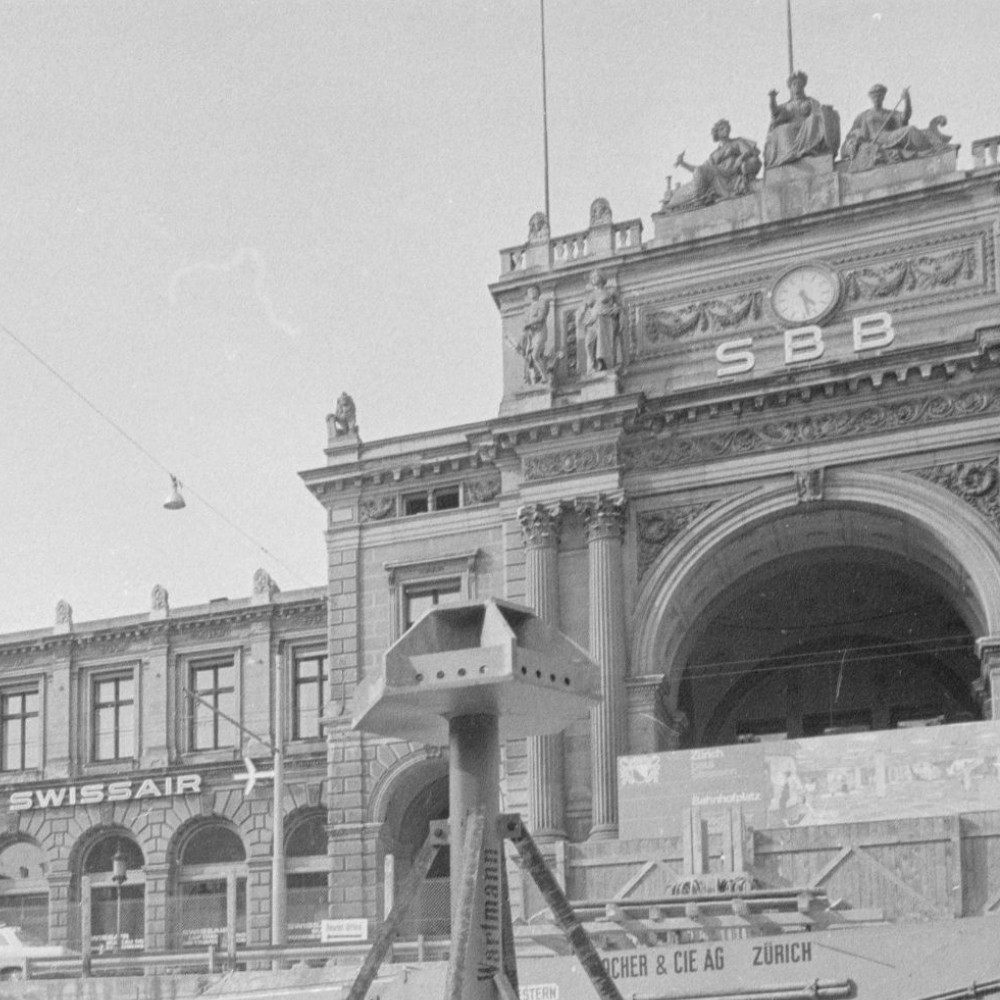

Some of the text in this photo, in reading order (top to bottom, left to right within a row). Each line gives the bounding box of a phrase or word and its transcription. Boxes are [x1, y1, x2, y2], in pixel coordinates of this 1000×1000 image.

[715, 312, 896, 378] SBB
[8, 773, 203, 812] SWISSAIR
[691, 791, 761, 806] Bahnhofplatz
[477, 848, 500, 982] Wartmann
[655, 954, 668, 976] &
[674, 949, 698, 975] CIE
[704, 946, 725, 972] AG
[752, 941, 813, 967] ZÜRICH
